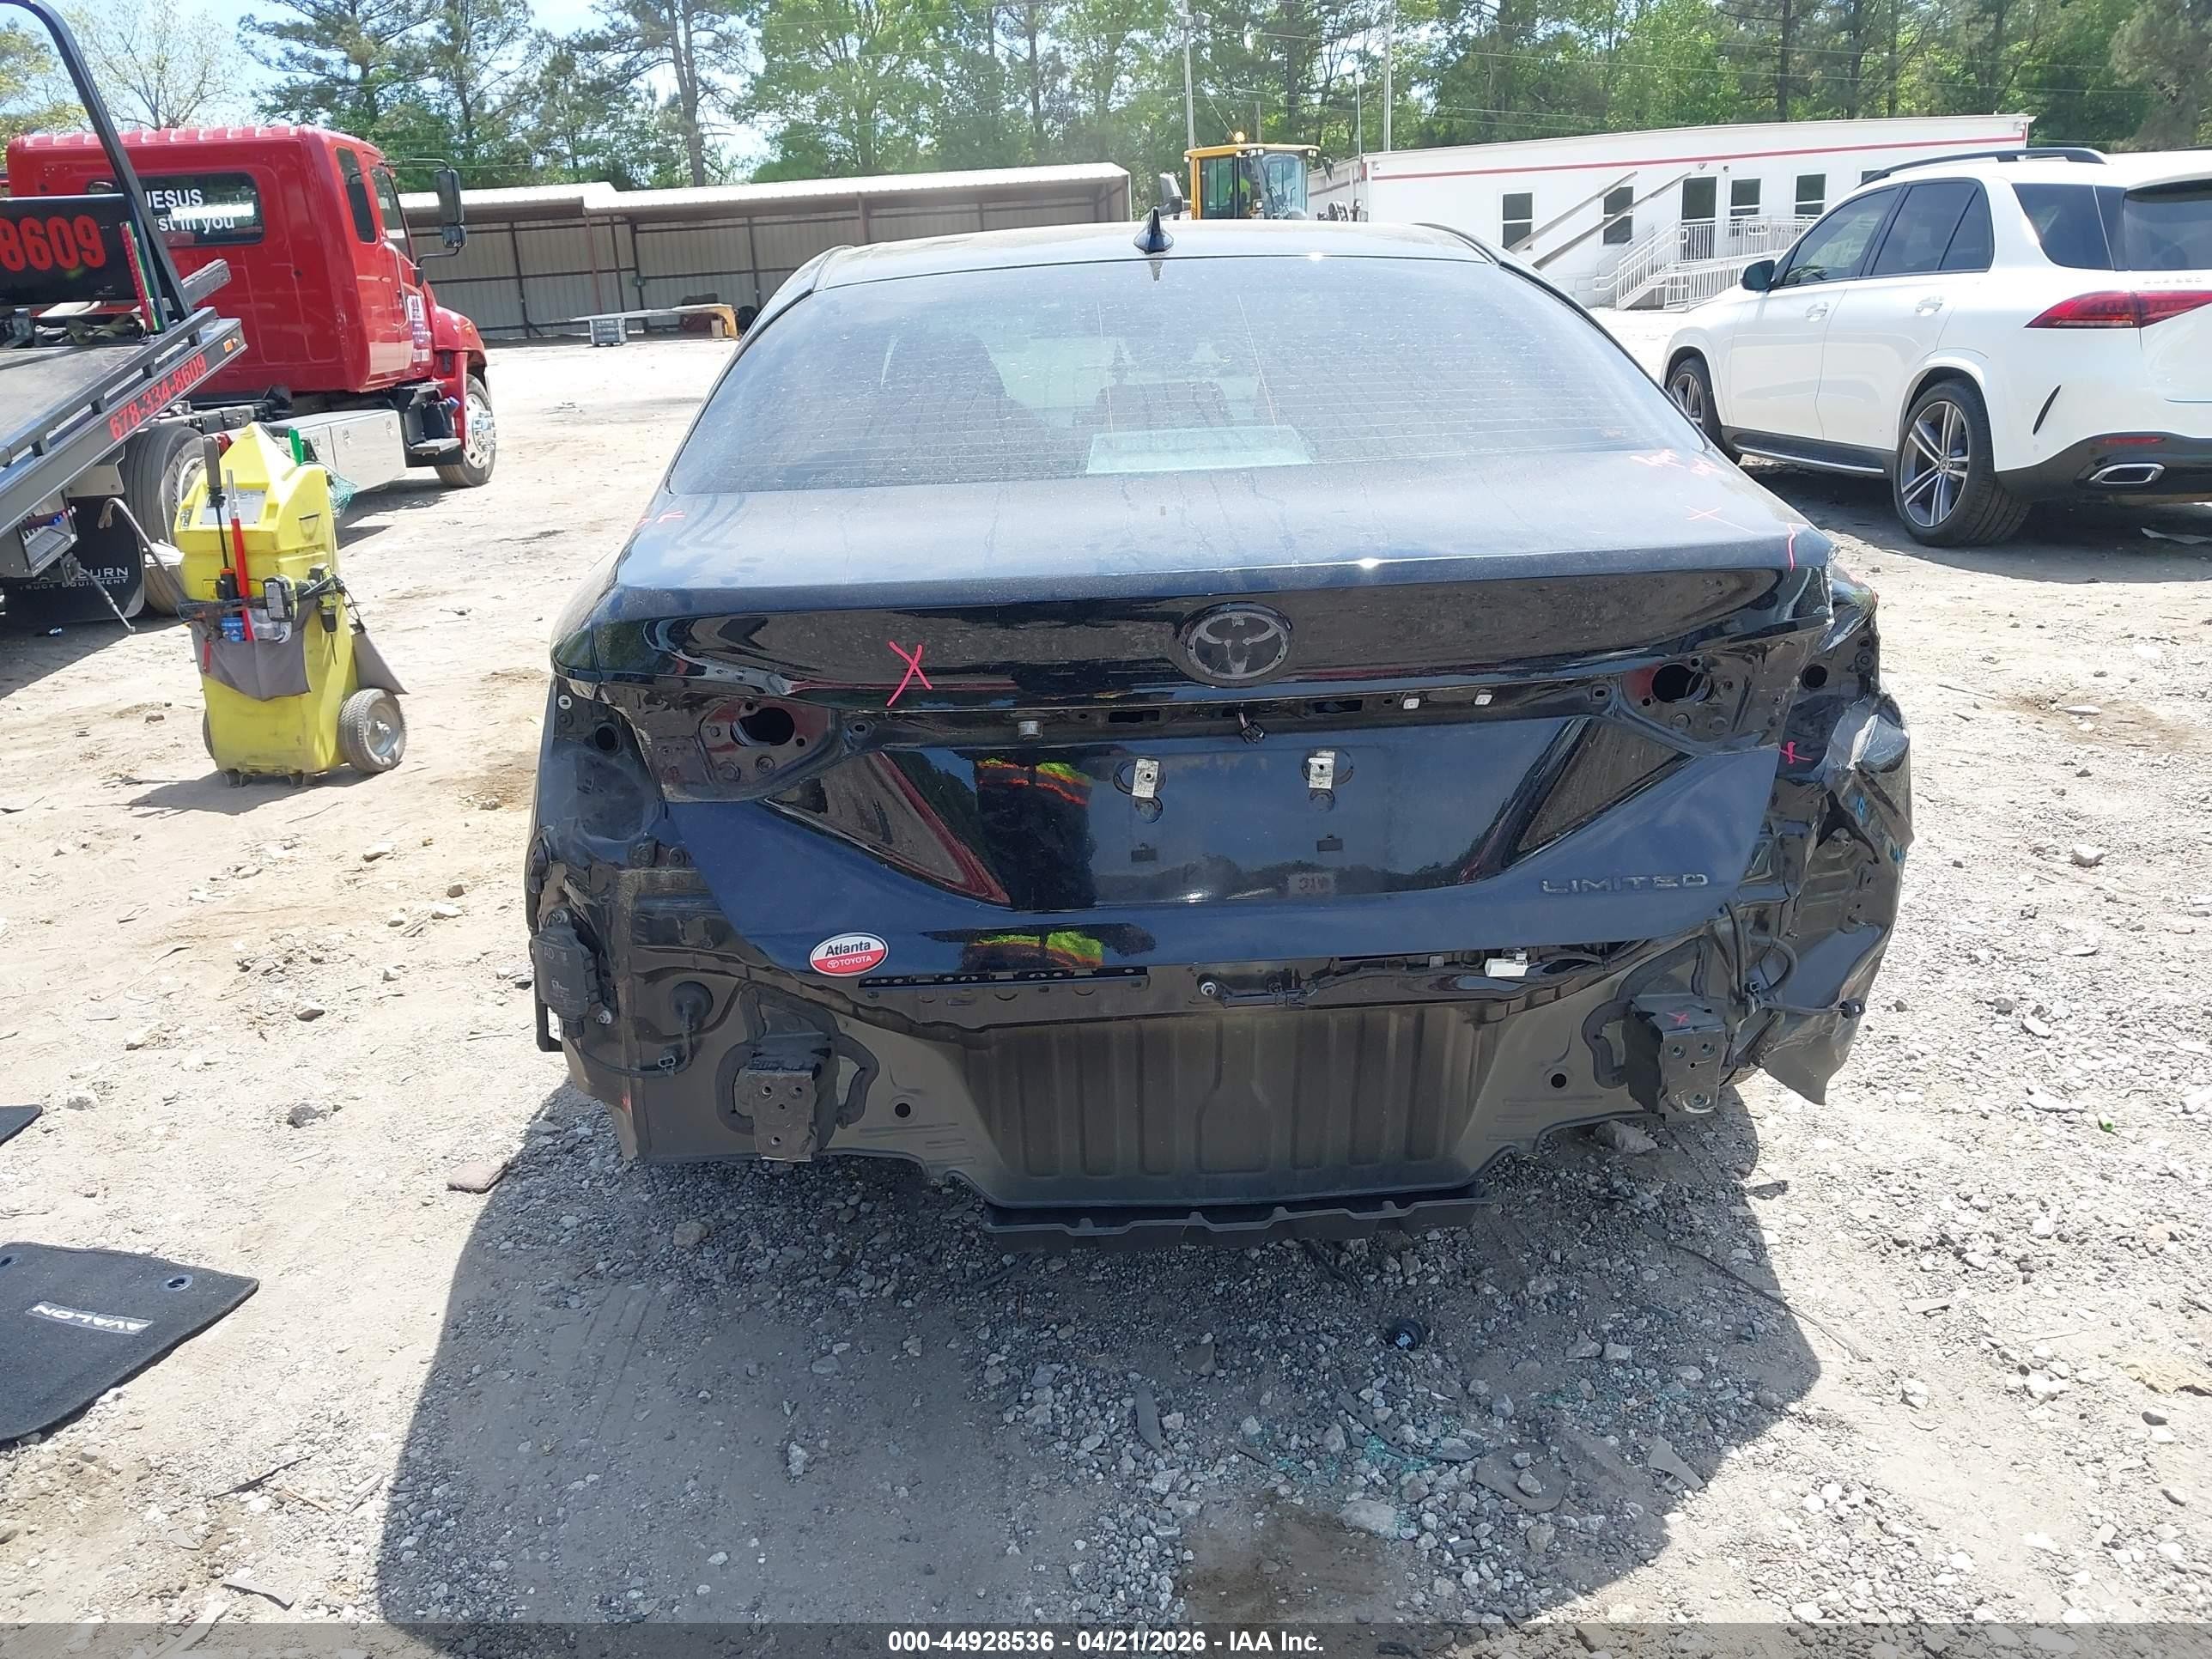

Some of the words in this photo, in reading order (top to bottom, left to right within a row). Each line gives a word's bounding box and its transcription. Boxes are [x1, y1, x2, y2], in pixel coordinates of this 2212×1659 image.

[145, 189, 204, 209] JESUS
[180, 216, 197, 231] in
[202, 216, 235, 234] you
[0, 215, 106, 271] 8609
[109, 352, 207, 441] 678-334-8609
[61, 578, 128, 588] EQUIMENT
[1542, 873, 1710, 893] LIMITED
[825, 941, 872, 957] Atlanta
[840, 956, 872, 966] TOYOTA
[32, 1304, 149, 1330] AVALON
